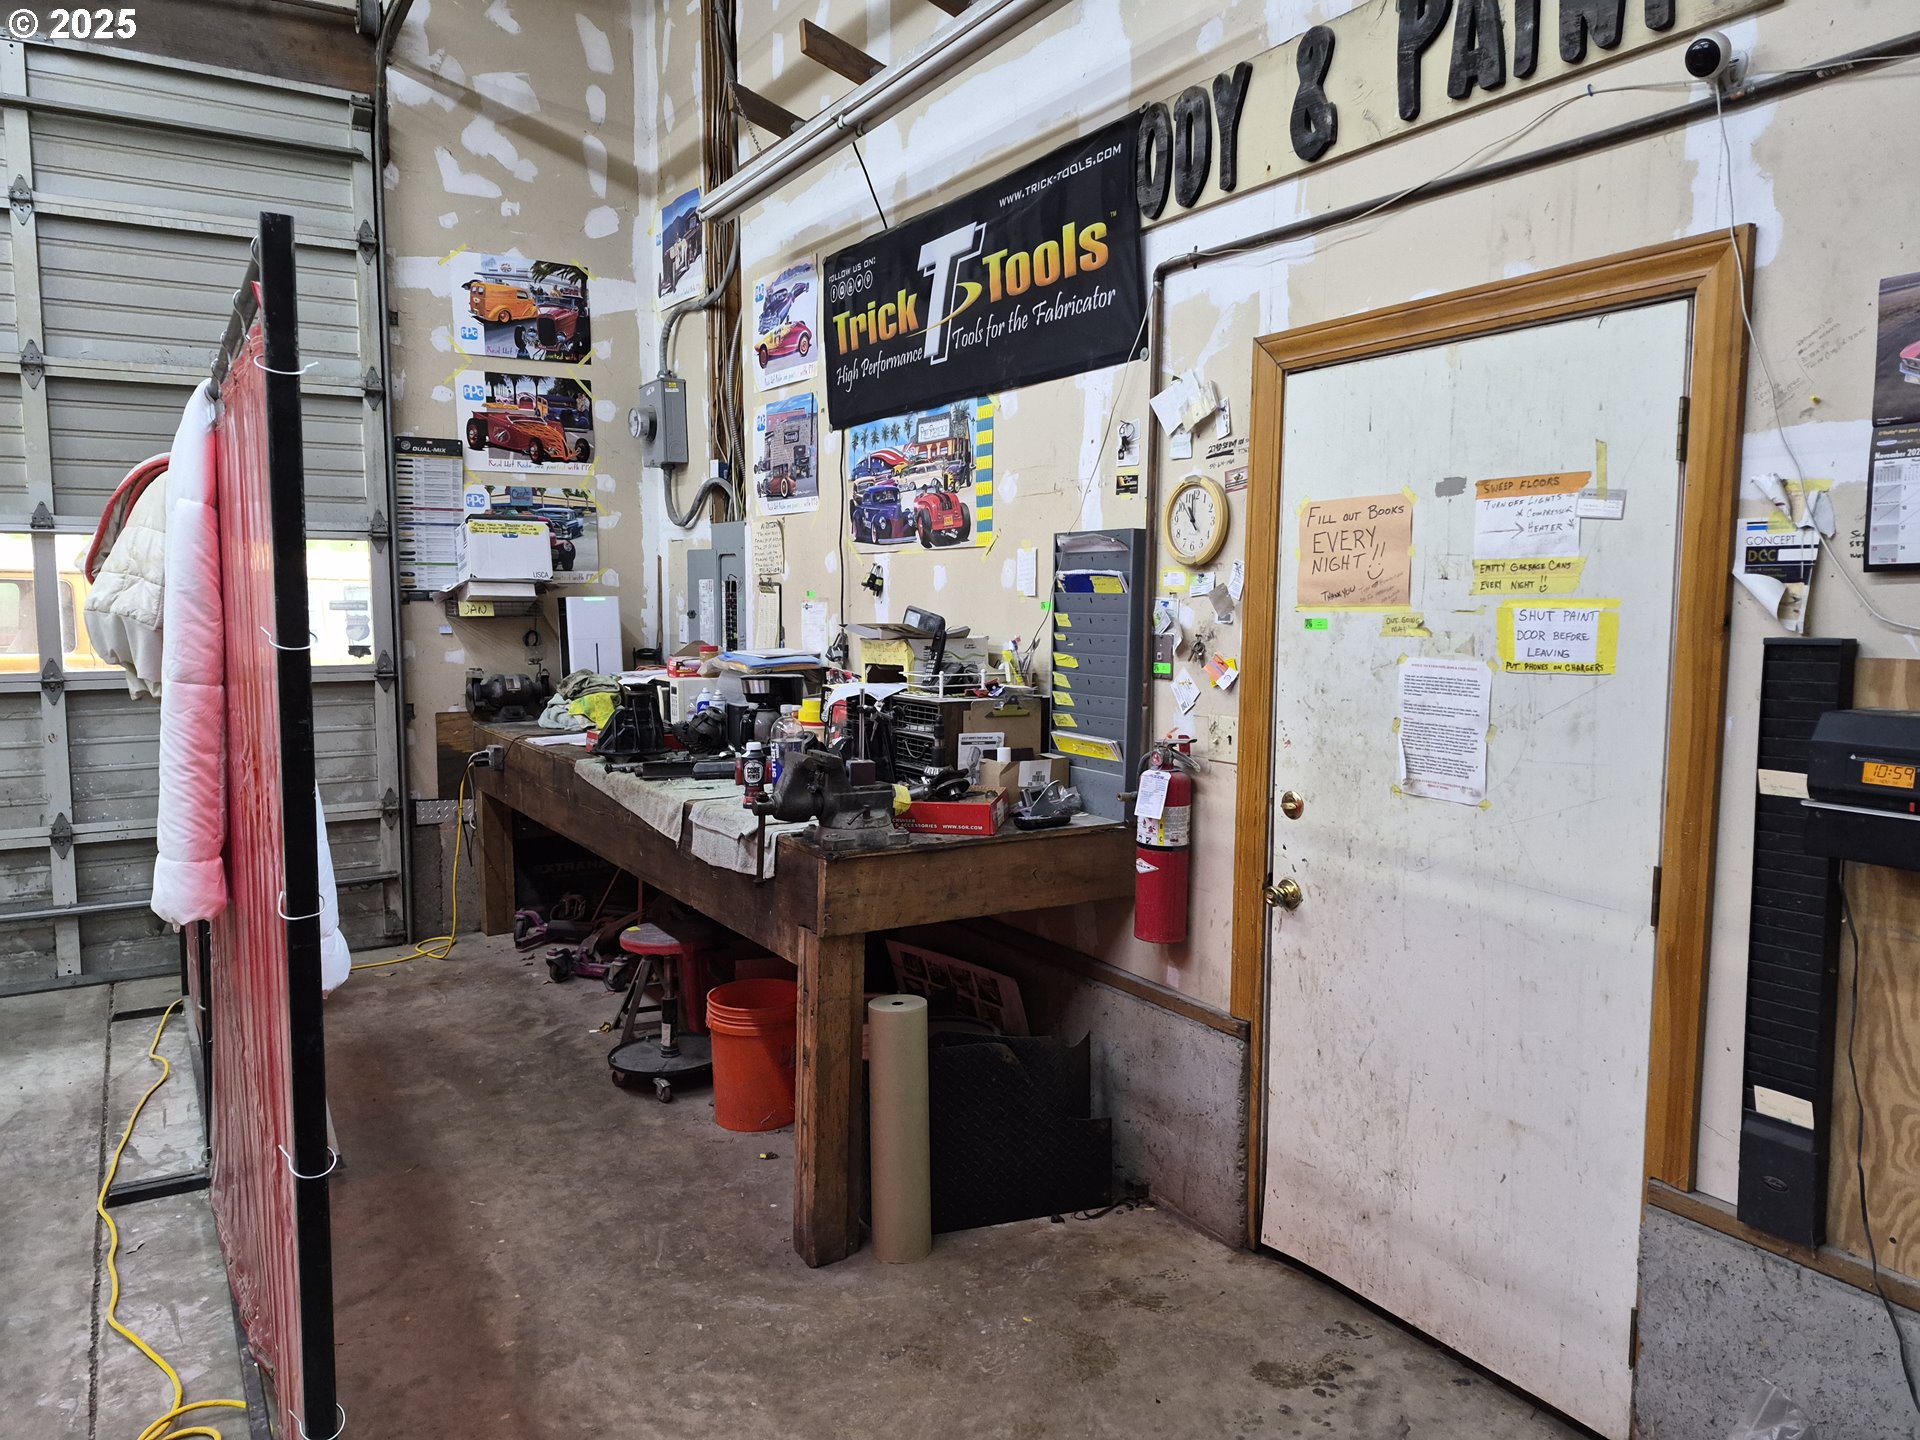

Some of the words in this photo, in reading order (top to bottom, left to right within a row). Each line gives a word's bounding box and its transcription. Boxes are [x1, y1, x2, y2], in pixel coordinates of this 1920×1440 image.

[1290, 25, 1338, 162] &
[1397, 0, 1676, 121] PAI
[999, 143, 1122, 208] WWW.TRICK-TOOLS.COM
[852, 262, 862, 273] US
[832, 288, 919, 356] Trick
[982, 221, 1109, 303] Tools
[461, 327, 479, 340] PPG
[836, 358, 859, 393] High
[861, 346, 923, 379] Performance
[951, 317, 984, 349] Tools
[985, 313, 1005, 347] for
[1008, 304, 1029, 334] the
[1032, 285, 1116, 326] Fabricator
[463, 385, 485, 401] PPG
[1875, 450, 1906, 459] November
[1483, 481, 1513, 494] SWEEP
[1519, 477, 1560, 491] FLOORS
[466, 493, 485, 507] PPG
[1528, 494, 1562, 506] LIGHTS
[1307, 506, 1336, 528] FILL
[1343, 512, 1361, 522] OUT
[1368, 504, 1405, 519] BOOKS
[1526, 505, 1574, 518] COMPRESSOR
[1527, 522, 1563, 533] HEATER
[1313, 525, 1376, 554] EVERY
[1746, 534, 1797, 546] CONCEPT
[1748, 549, 1776, 562] DCC
[1480, 562, 1506, 574] EMPTY
[533, 571, 550, 579] USCA
[1511, 580, 1534, 590] NIGHT
[464, 604, 487, 615] JAN
[1518, 609, 1555, 621] SHUT
[1563, 610, 1601, 622] PAINT
[1517, 630, 1546, 641] DOOR
[1553, 632, 1590, 641] BEFORE
[1527, 647, 1570, 659] LEAVING
[1505, 662, 1520, 670] PUT
[1524, 663, 1548, 671] PHONES
[1565, 664, 1604, 673] CHARGERS
[1873, 764, 1915, 781] 10:59
